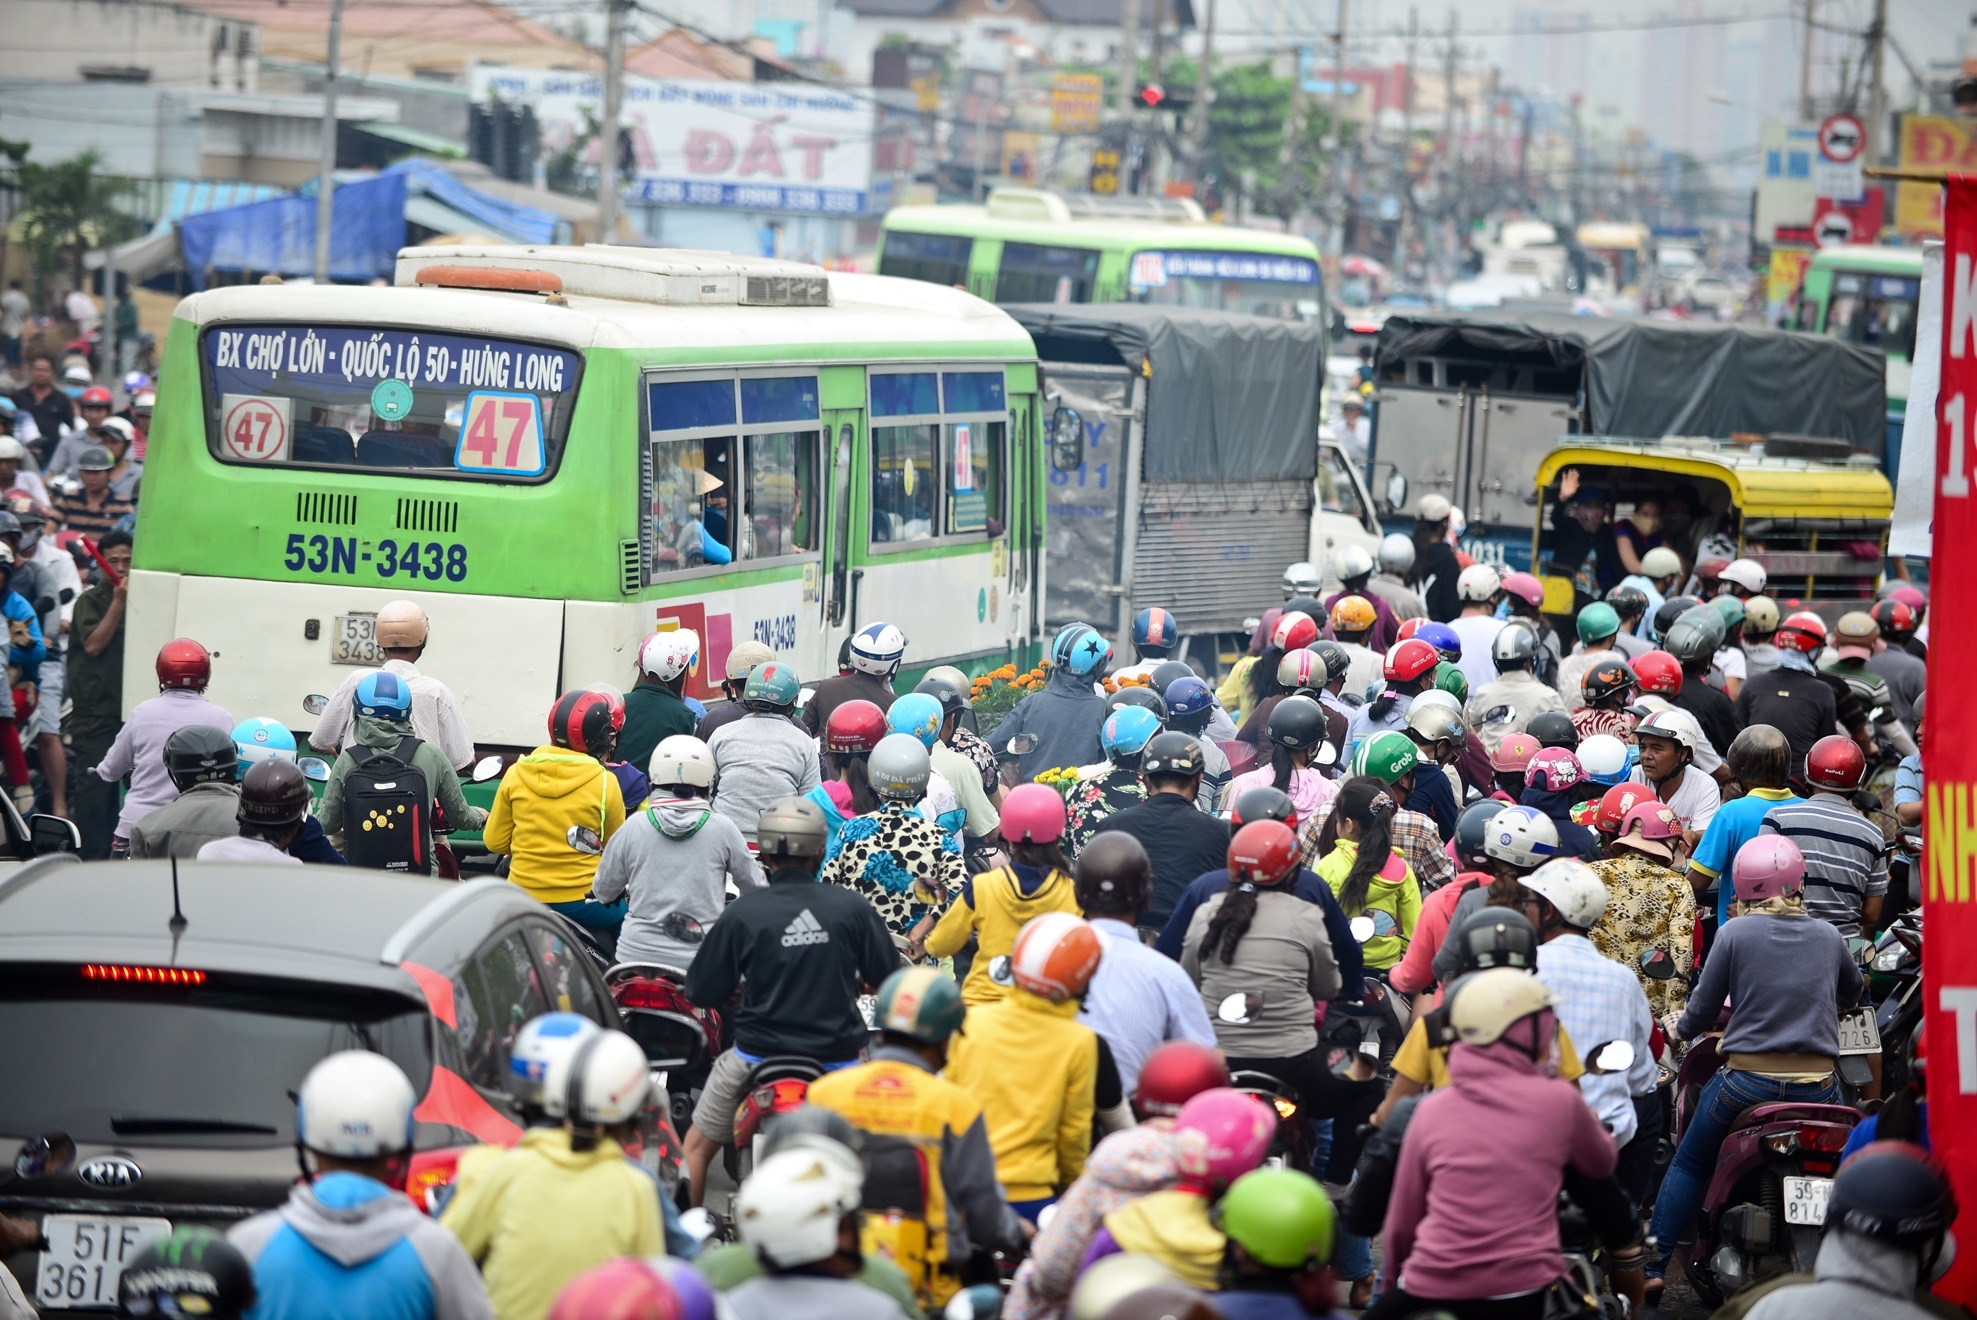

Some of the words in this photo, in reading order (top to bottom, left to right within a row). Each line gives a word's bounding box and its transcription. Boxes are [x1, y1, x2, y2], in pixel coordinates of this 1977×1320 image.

[217, 331, 244, 368] BX
[246, 330, 287, 380] CHỢ
[288, 328, 327, 374] LỚN
[341, 333, 392, 383] QUỐC
[395, 336, 420, 387] LỘ
[424, 346, 449, 383] 50
[459, 344, 511, 389] HƯNG
[513, 353, 564, 392] LONG
[234, 411, 274, 453] 47
[467, 400, 533, 468] 47
[284, 533, 468, 582] 53N-3438
[1390, 752, 1413, 773] Grab
[780, 929, 830, 947] adidas
[82, 1162, 131, 1187] KIA
[73, 1223, 141, 1262] 51F
